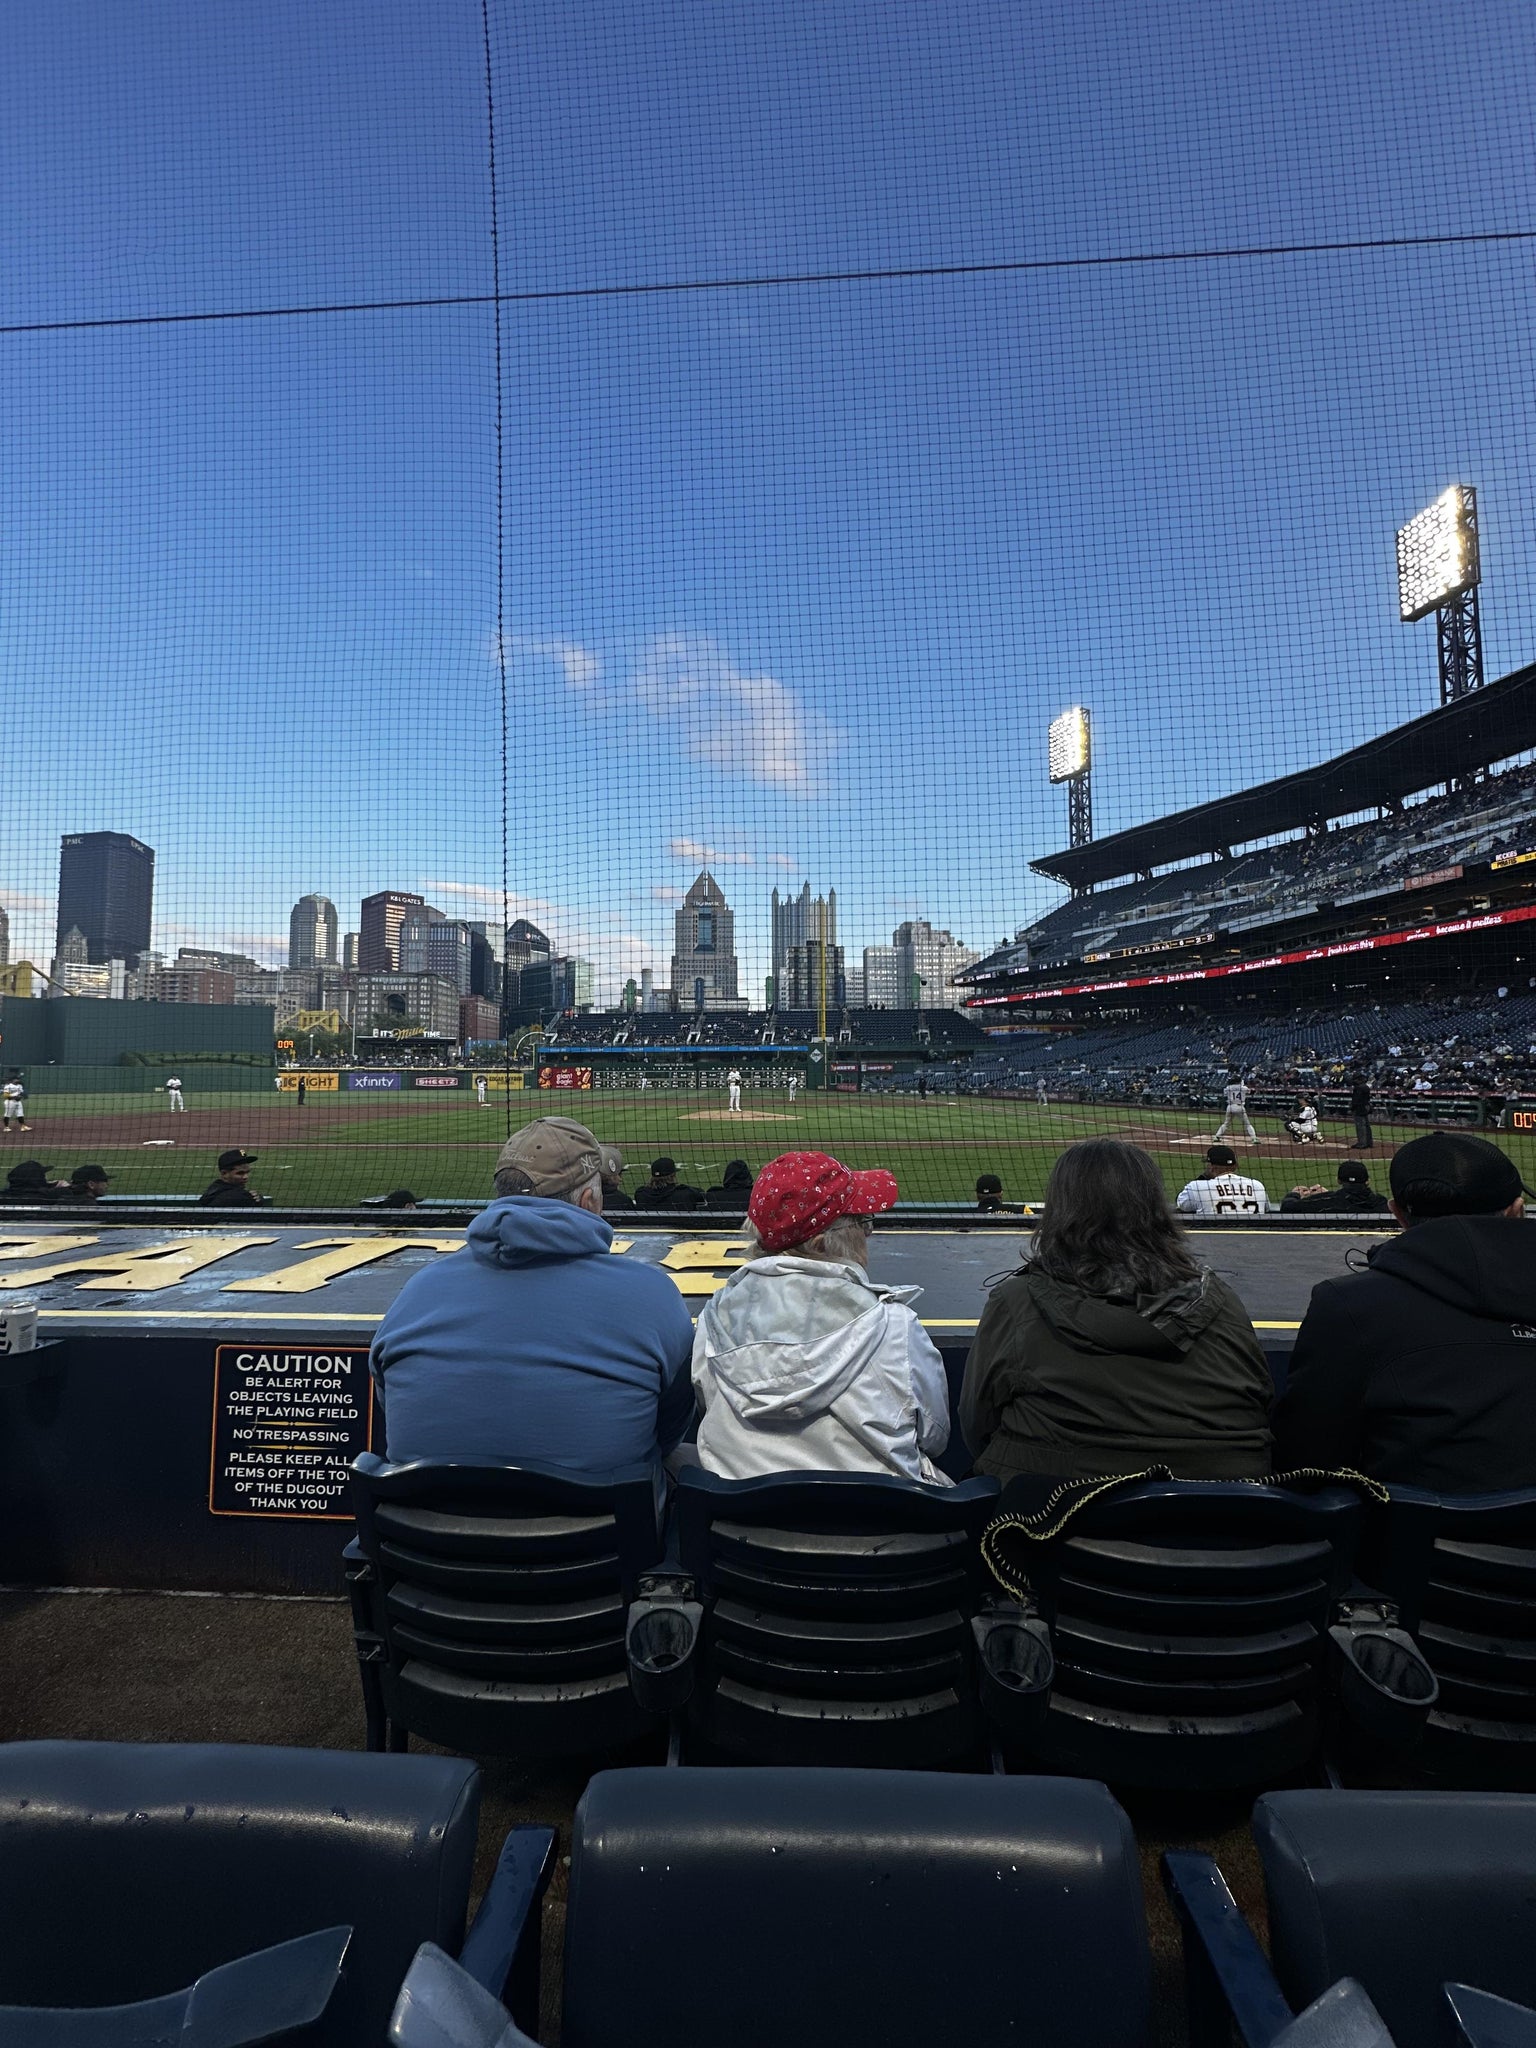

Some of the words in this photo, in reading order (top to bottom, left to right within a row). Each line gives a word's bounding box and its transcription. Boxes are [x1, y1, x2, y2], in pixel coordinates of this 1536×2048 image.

[402, 897, 421, 905] GATES
[393, 1027, 428, 1041] Miller
[306, 1077, 335, 1087] IGHT
[355, 1076, 394, 1088] xfinity
[1232, 1092, 1242, 1101] 14
[1216, 1184, 1253, 1197] BELLO
[236, 1353, 352, 1374] CAUTION
[245, 1377, 263, 1387] BE
[266, 1377, 311, 1388] ALERT
[314, 1378, 342, 1389] FOR
[229, 1391, 291, 1403] OBJECTS
[294, 1392, 353, 1404] LEAVING
[226, 1405, 253, 1416] THE
[257, 1406, 315, 1418] PLAYING
[318, 1408, 358, 1419] FIELD
[233, 1429, 254, 1440] NO
[256, 1430, 350, 1443] TRESPASSING
[229, 1452, 282, 1464] PLEASE
[285, 1454, 322, 1465] KEEP
[325, 1455, 352, 1466] ALL
[225, 1467, 265, 1478] ITEMS
[267, 1468, 295, 1479] OFF
[298, 1469, 325, 1480] THE
[235, 1482, 255, 1492] OF
[256, 1482, 283, 1494] THE
[286, 1483, 344, 1495] DUGOUT
[249, 1497, 297, 1509] THANK
[300, 1499, 328, 1510] YOU
